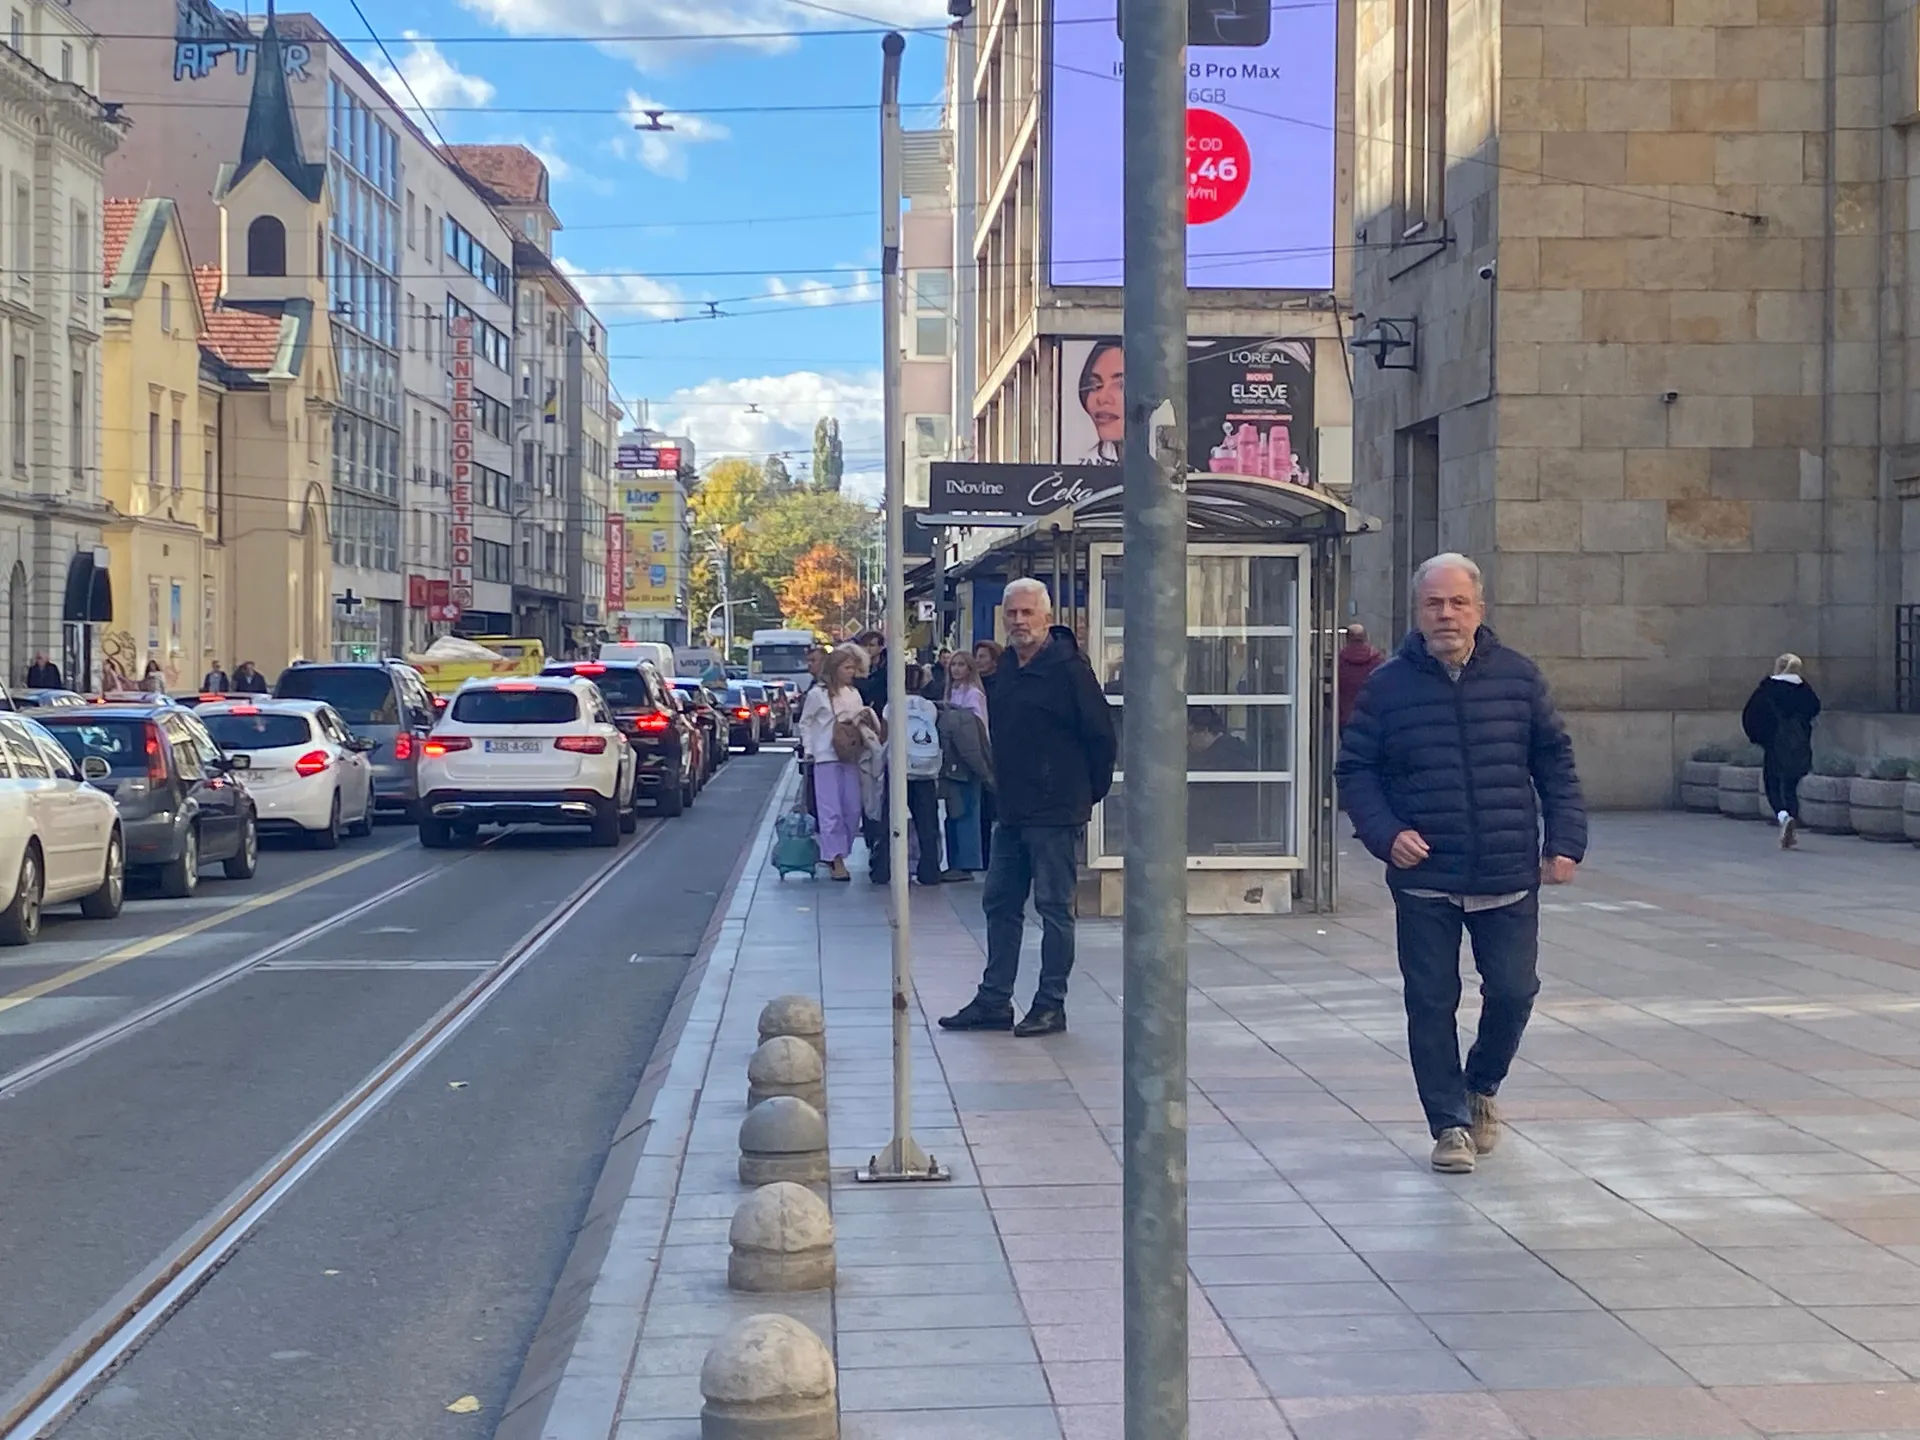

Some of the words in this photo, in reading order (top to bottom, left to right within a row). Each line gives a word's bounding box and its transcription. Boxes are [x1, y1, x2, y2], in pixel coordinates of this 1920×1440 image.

[174, 42, 311, 82] AFTR
[1188, 63, 1200, 78] 8
[1205, 63, 1237, 79] Pro
[1242, 64, 1280, 79] Max
[1188, 88, 1227, 104] 6GB
[1199, 137, 1223, 152] OD
[1186, 156, 1239, 185] ,46
[1231, 384, 1288, 399] ELSEVE
[454, 339, 470, 585] ENERGOPETROL
